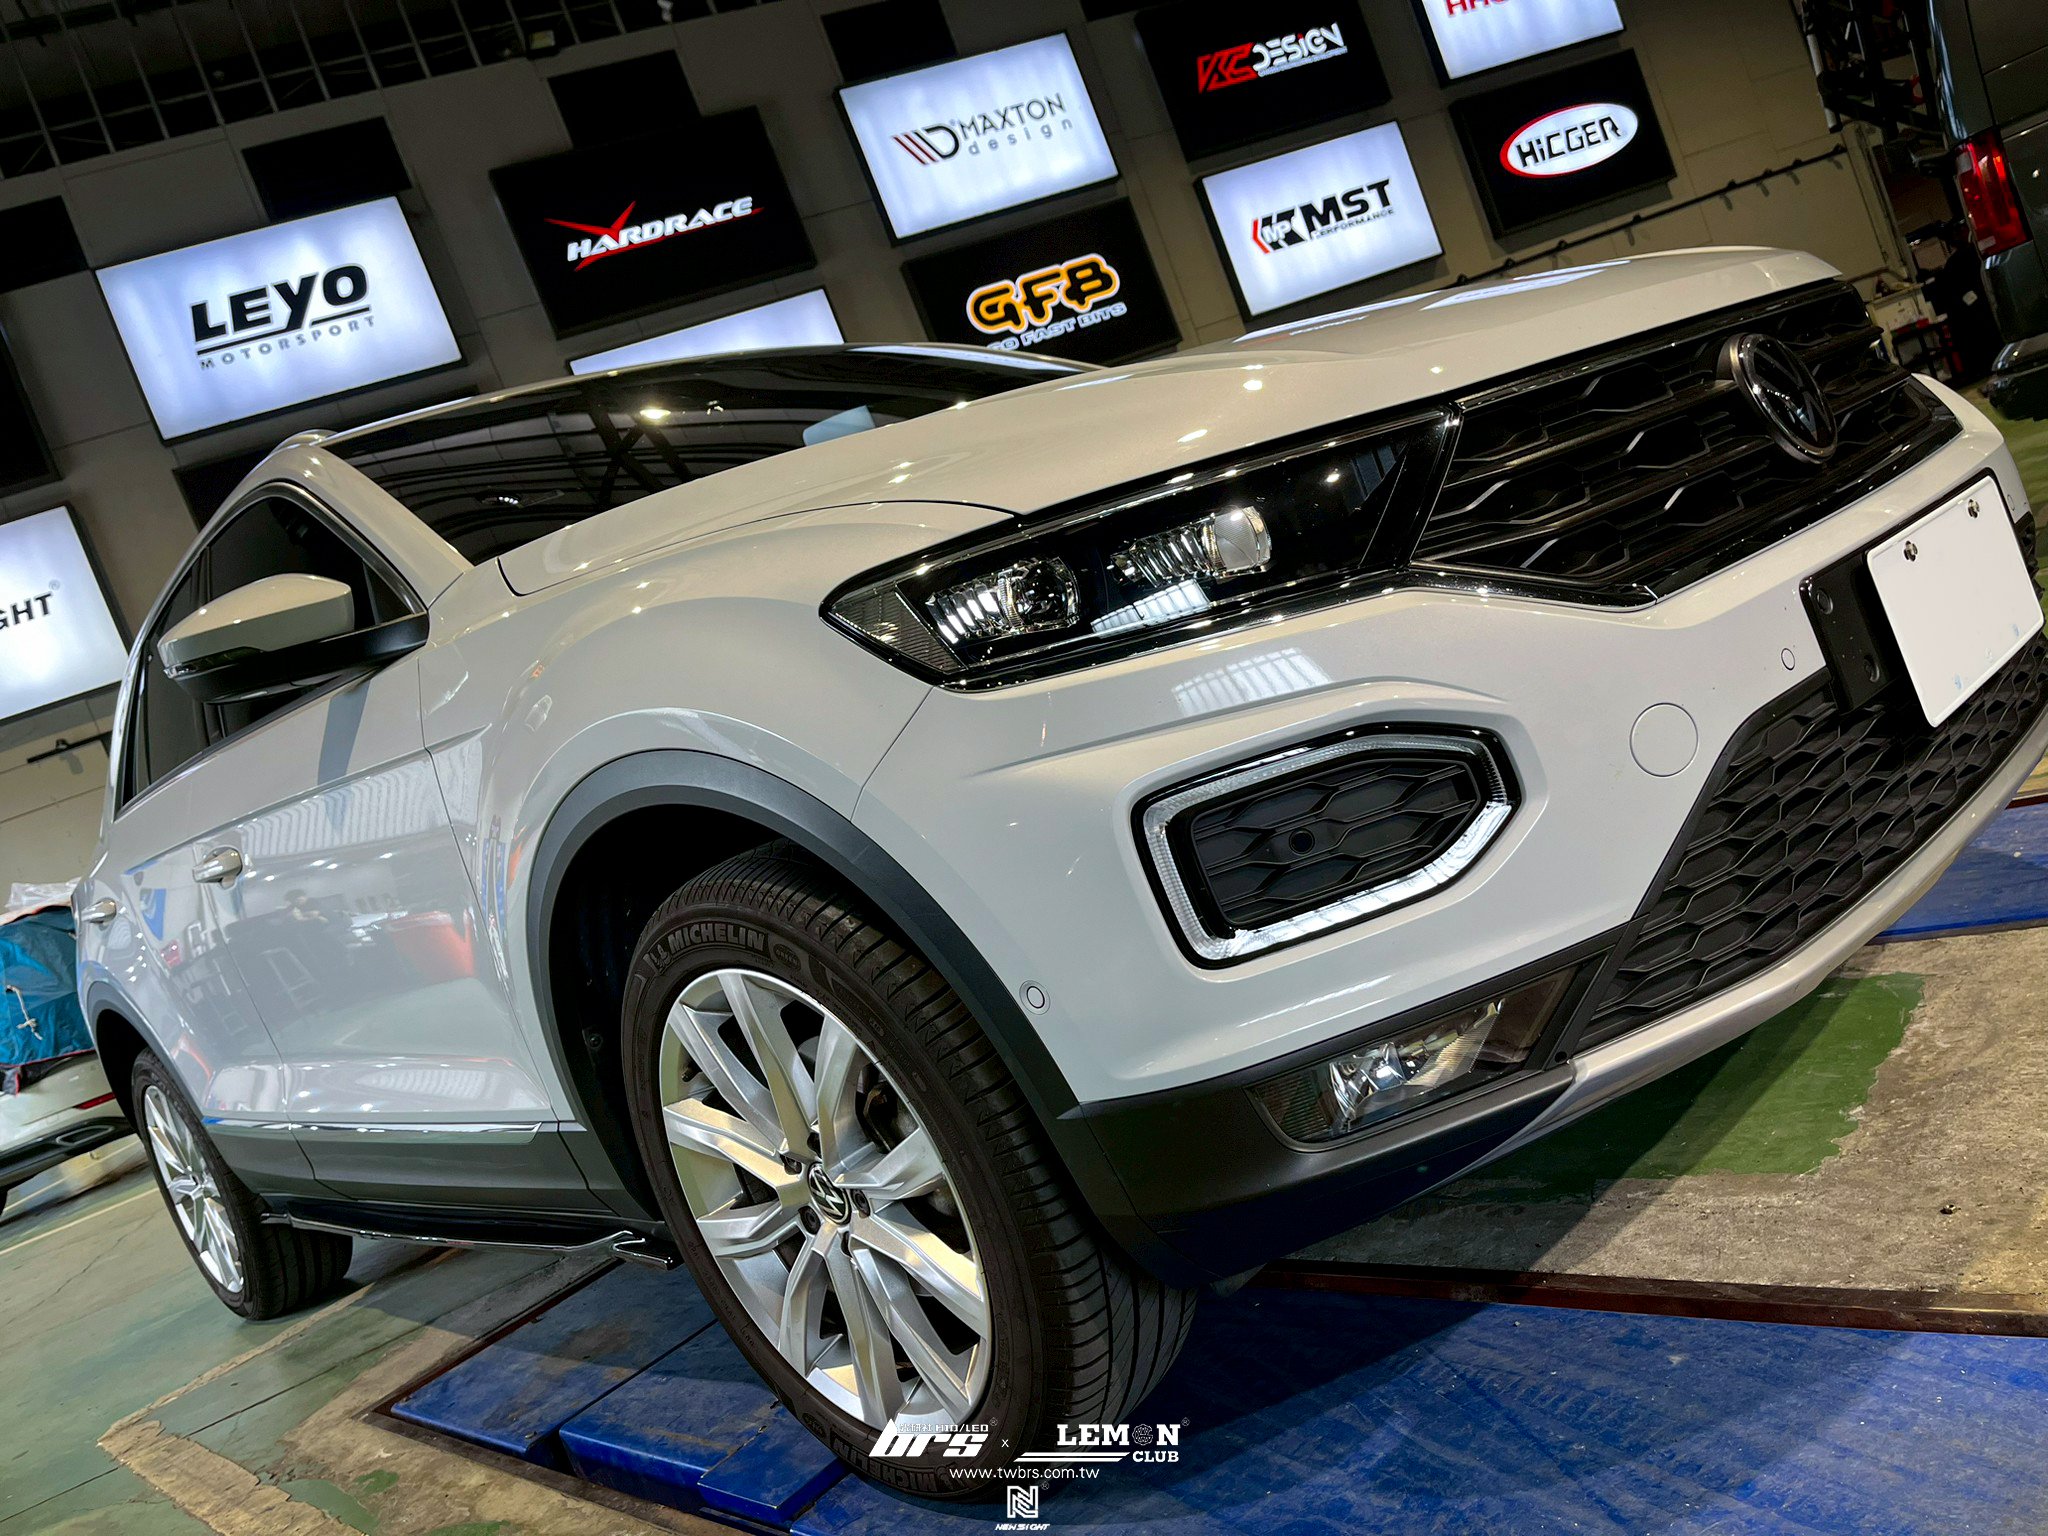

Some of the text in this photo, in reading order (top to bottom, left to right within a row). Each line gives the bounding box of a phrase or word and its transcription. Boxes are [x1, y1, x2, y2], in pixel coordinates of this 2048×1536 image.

[958, 92, 1067, 140] MAXTON
[968, 117, 1073, 156] design
[567, 196, 753, 262] HARDRACE
[1299, 178, 1391, 236] MST
[1309, 208, 1394, 240] PERFORMANCE
[966, 253, 1121, 335] GFB
[200, 315, 375, 371] MOTORSPORT
[1020, 317, 1076, 346] FAST
[1077, 302, 1128, 328] BITS
[667, 922, 765, 953] MICHELIN
